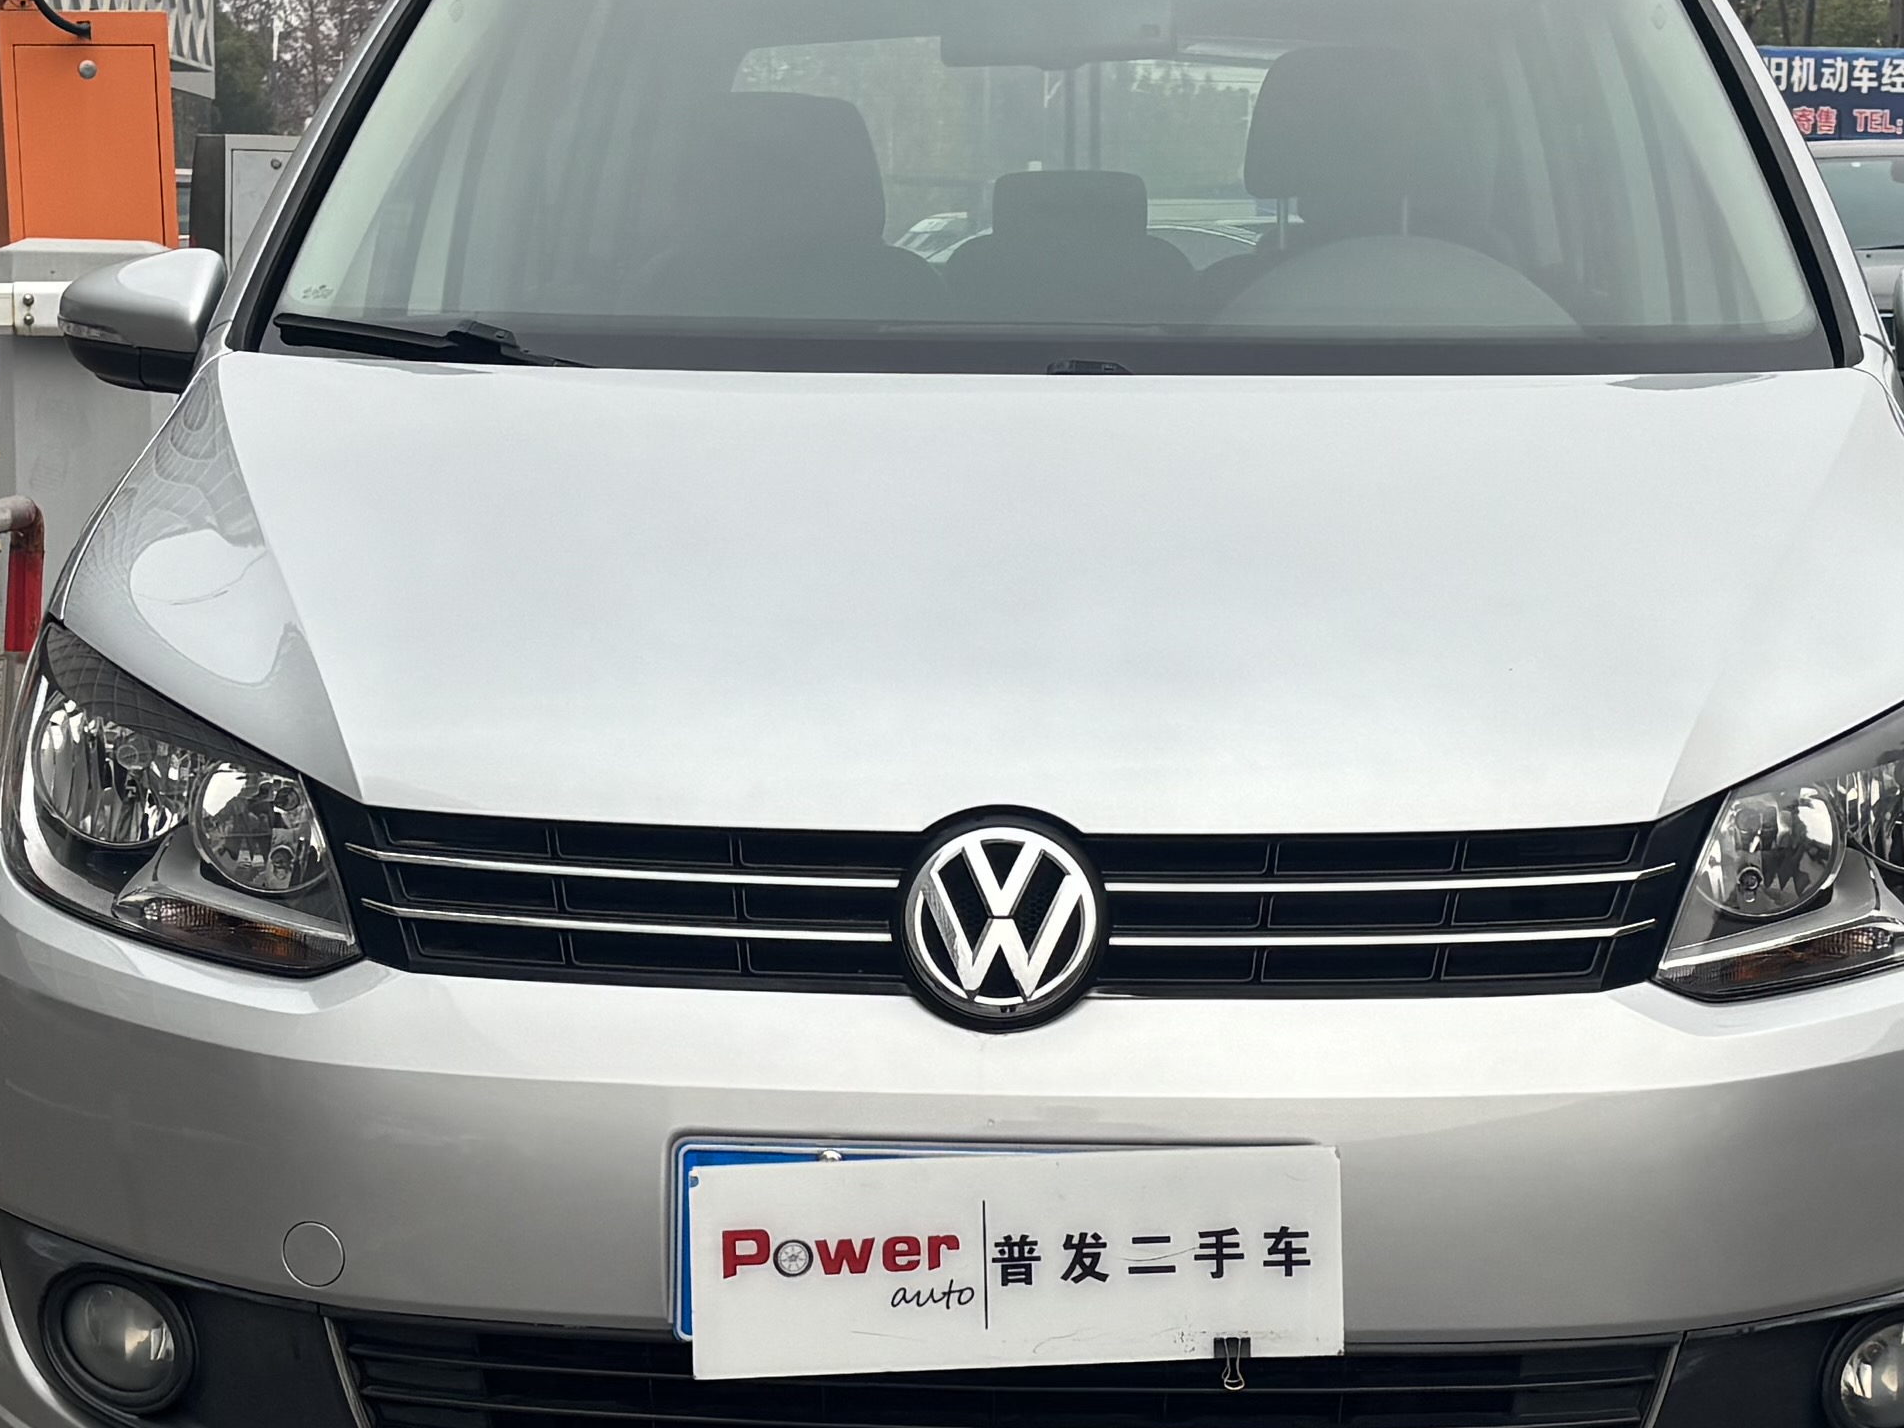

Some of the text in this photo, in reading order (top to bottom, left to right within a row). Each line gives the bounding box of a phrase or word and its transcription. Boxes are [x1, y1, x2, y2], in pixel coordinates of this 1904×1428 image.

[722, 1228, 960, 1279] Power
[991, 1225, 1311, 1287] 普发二手车
[890, 1279, 976, 1310] auto
